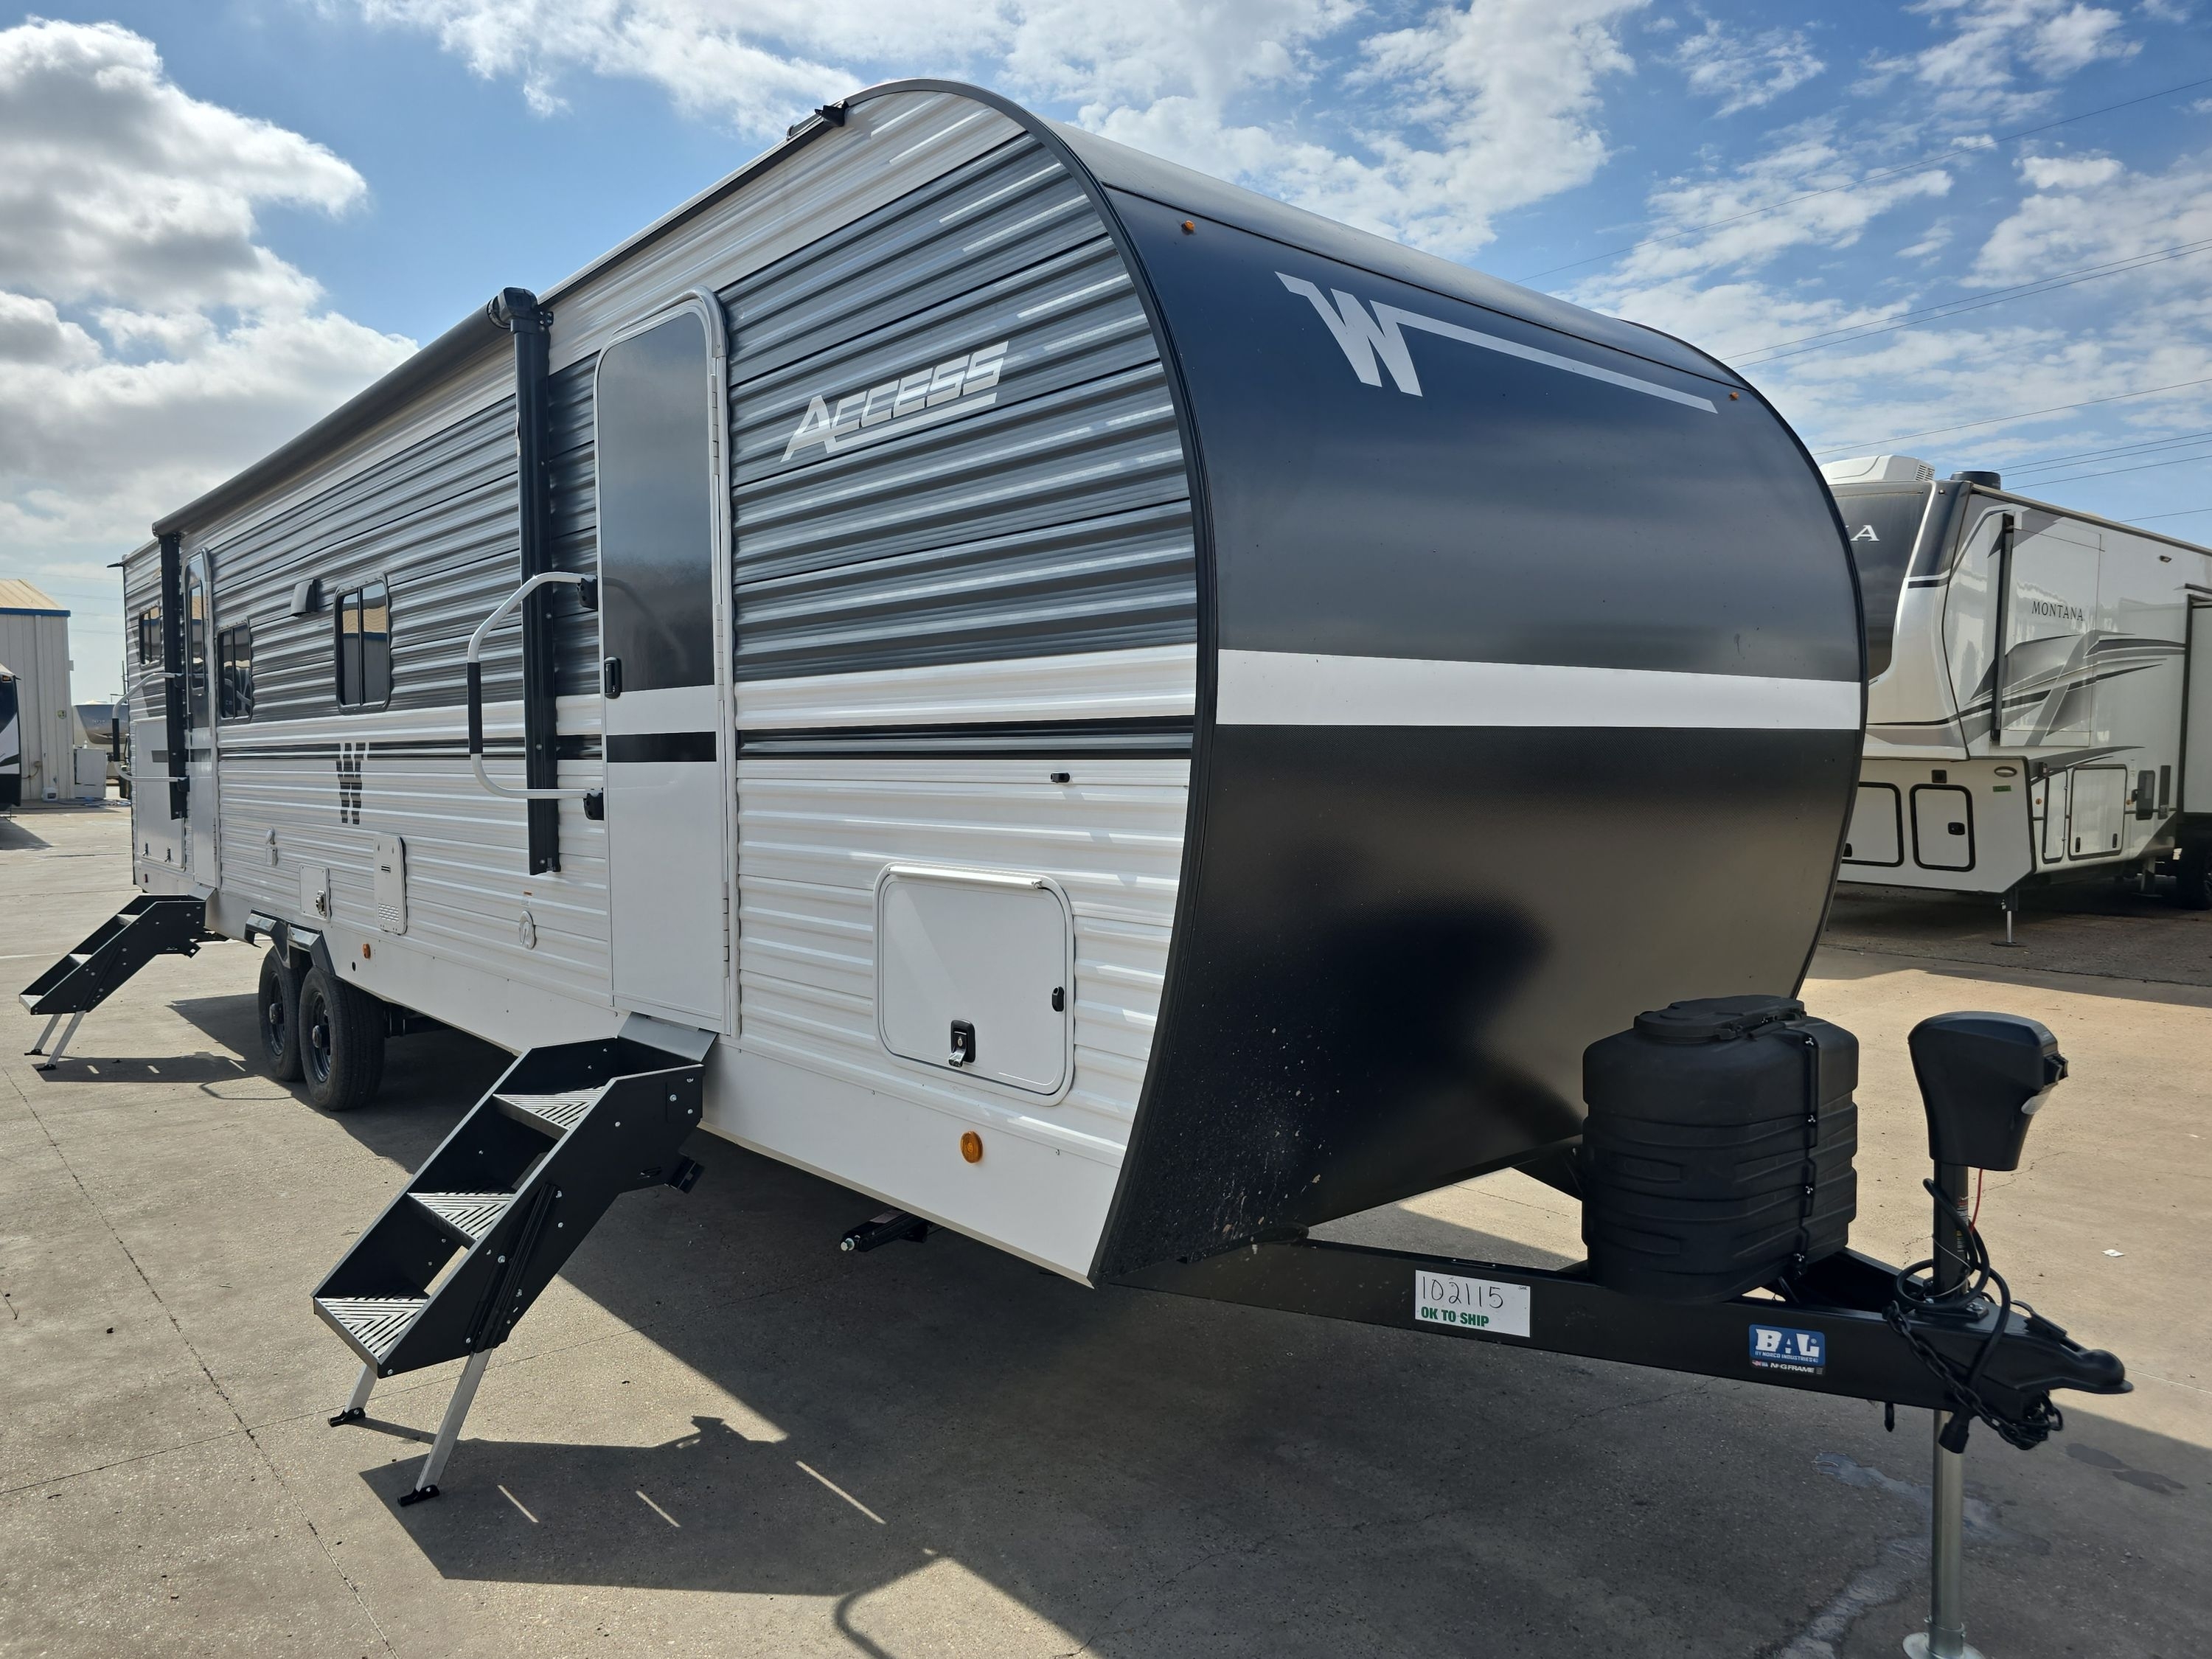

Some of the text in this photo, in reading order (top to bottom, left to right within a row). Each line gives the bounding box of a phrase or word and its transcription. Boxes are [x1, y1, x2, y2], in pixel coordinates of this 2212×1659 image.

[780, 341, 1009, 462] ACCESS
[2031, 600, 2084, 622] MONTANA
[1422, 1276, 1503, 1309] 102115
[1421, 1306, 1489, 1328] OK TO SHIP
[1756, 1329, 1820, 1357] BAL
[1762, 1351, 1781, 1359] NORCO
[1781, 1354, 1812, 1363] INDUSTRIES
